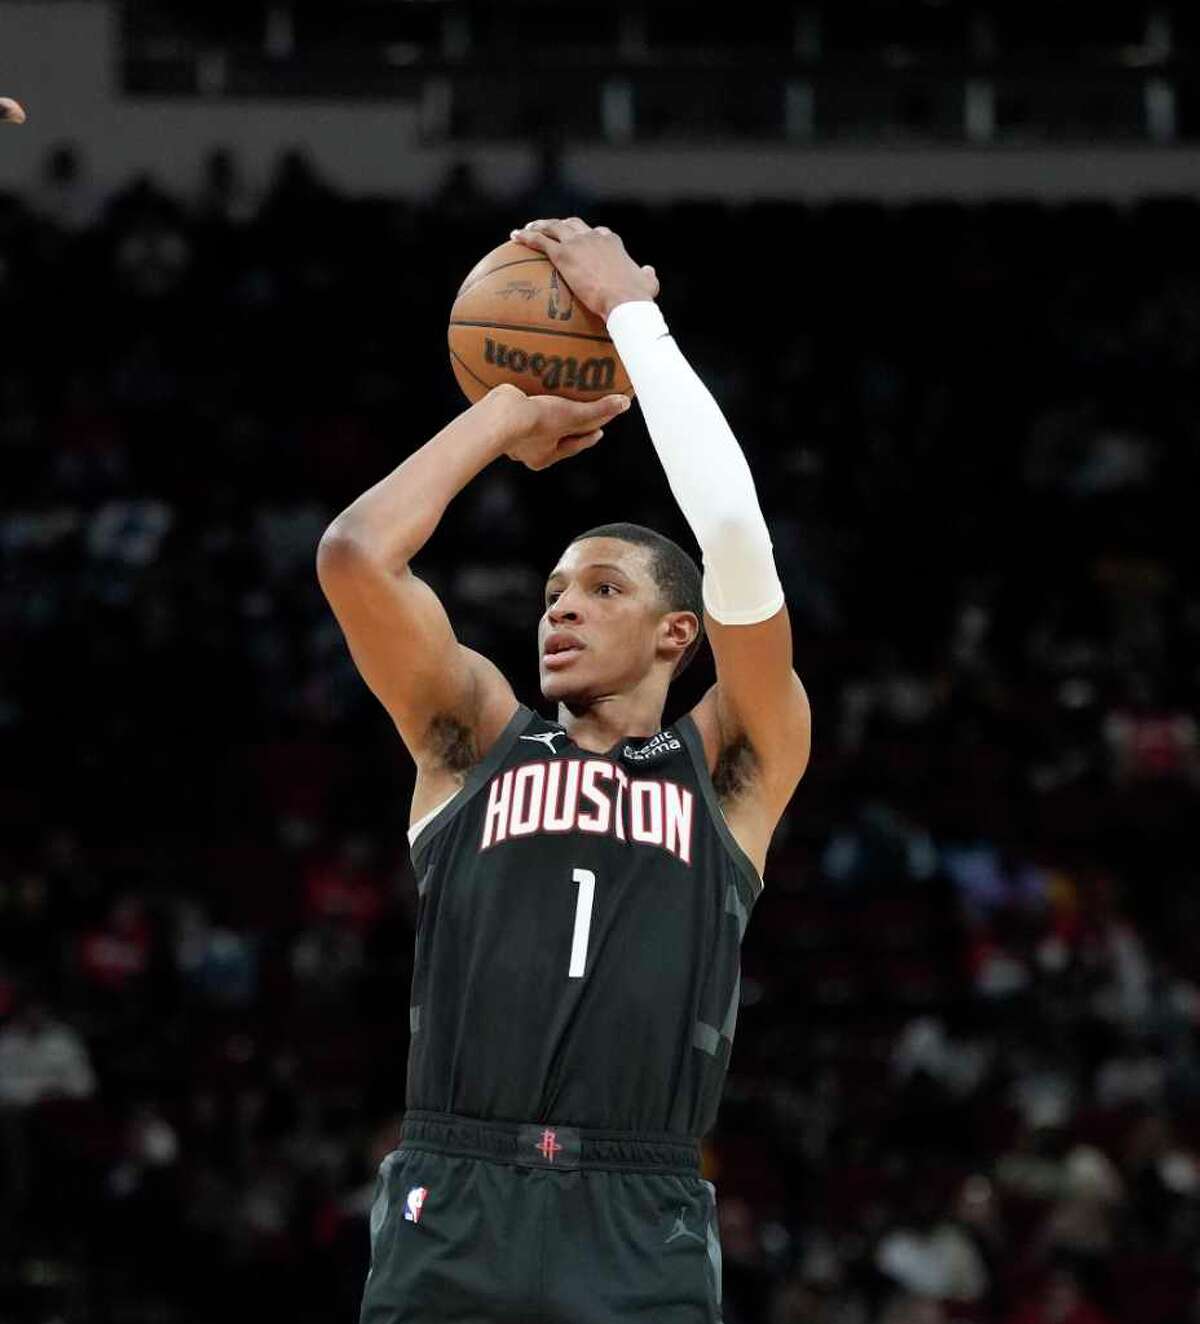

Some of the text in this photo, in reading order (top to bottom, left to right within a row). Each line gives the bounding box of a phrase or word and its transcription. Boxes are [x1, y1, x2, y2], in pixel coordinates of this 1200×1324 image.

[484, 335, 616, 391] Wilson
[478, 758, 695, 867] HOUSTON
[567, 867, 596, 978] 1
